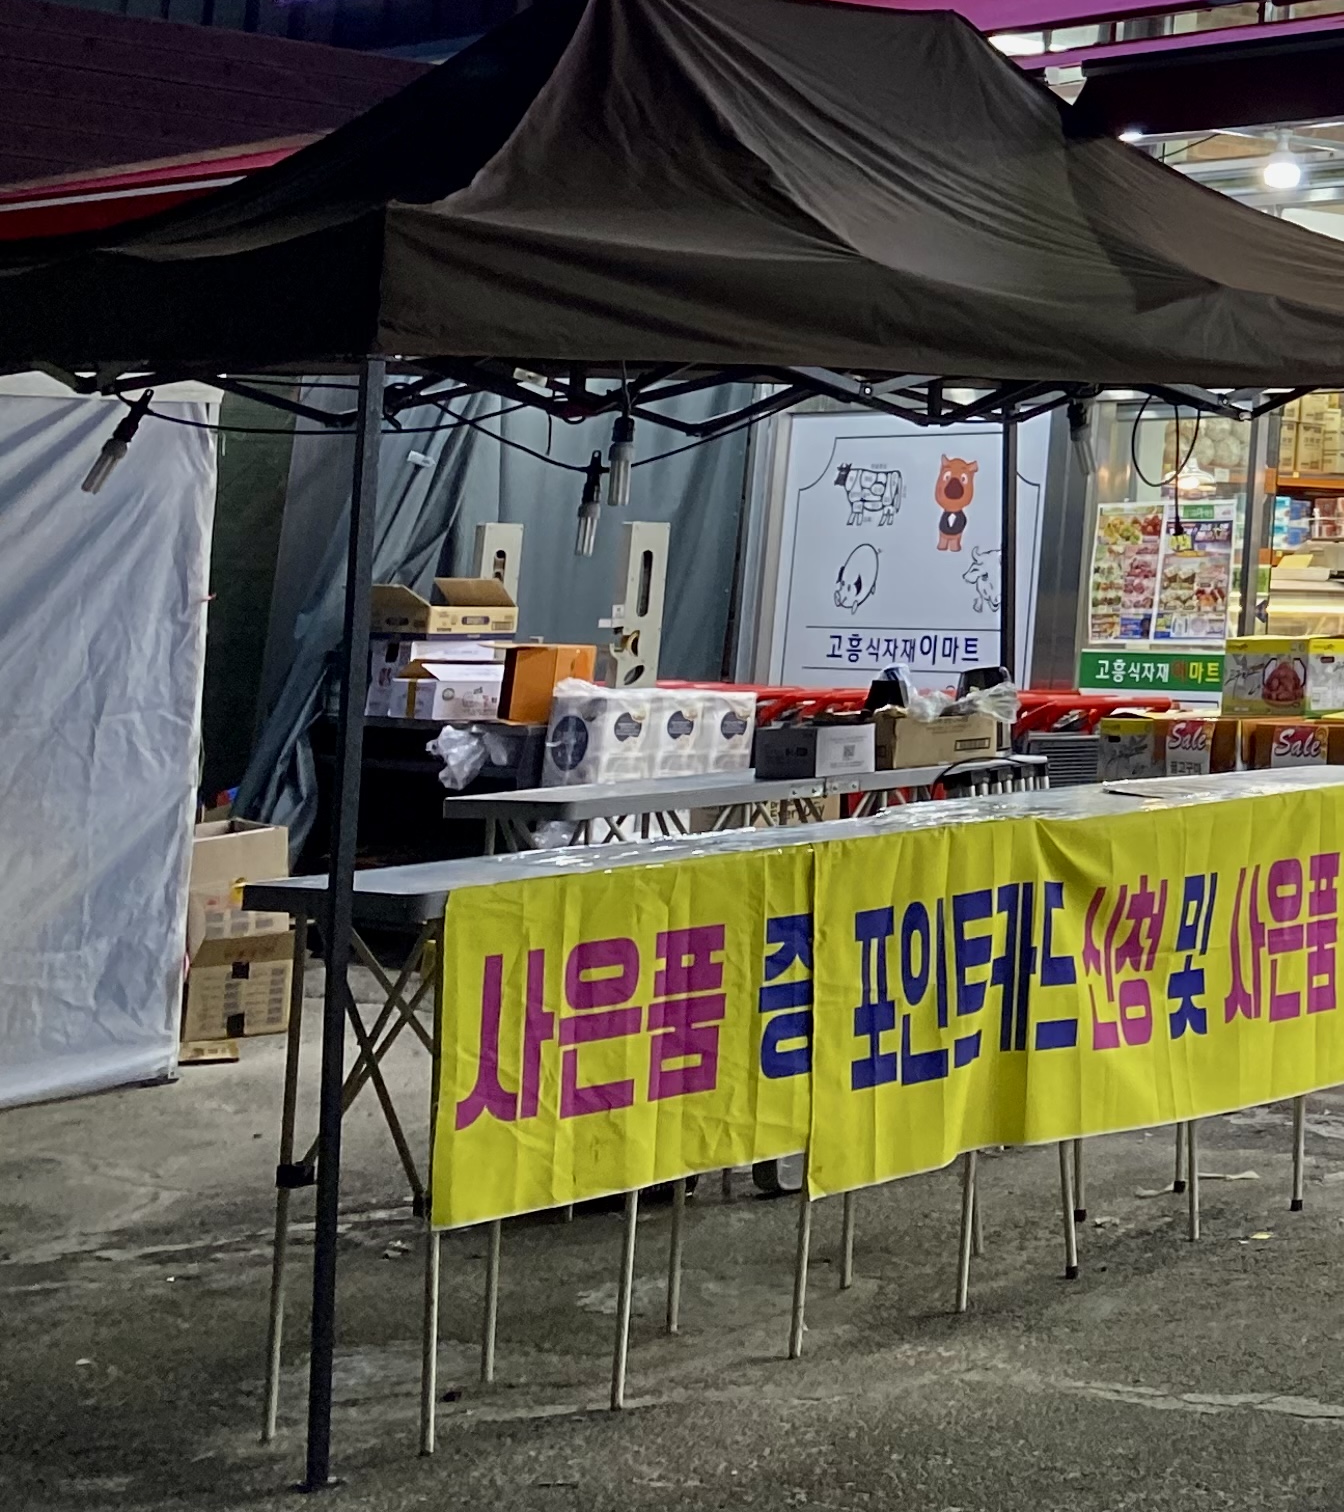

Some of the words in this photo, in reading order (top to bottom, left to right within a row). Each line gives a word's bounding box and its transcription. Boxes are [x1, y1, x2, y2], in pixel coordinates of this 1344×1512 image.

[1168, 722, 1206, 751] Sale
[1273, 727, 1321, 759] Sale
[1080, 872, 1169, 1051] 신청
[1168, 870, 1219, 1040] 및
[1224, 850, 1341, 1026] 사은품
[454, 922, 727, 1130] 사은품
